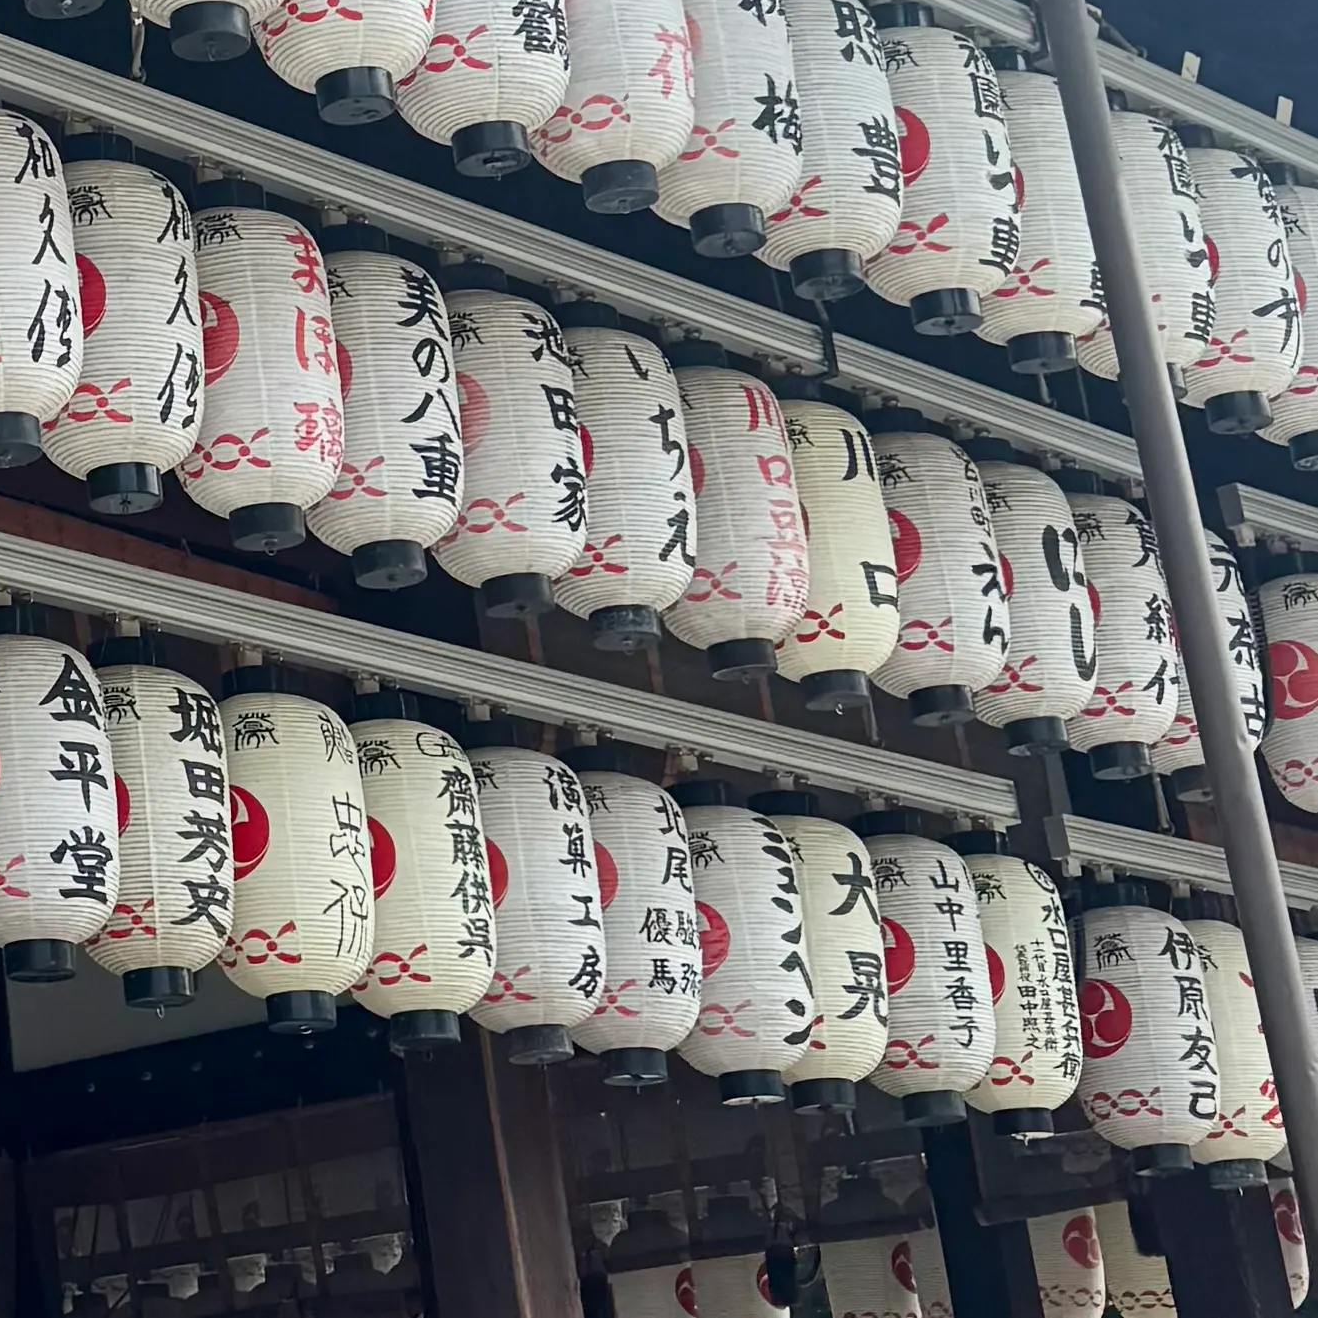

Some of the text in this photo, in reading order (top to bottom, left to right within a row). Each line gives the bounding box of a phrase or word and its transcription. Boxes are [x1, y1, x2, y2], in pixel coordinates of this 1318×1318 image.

[396, 265, 463, 507] 美の八重
[38, 653, 113, 906] 金平堂
[653, 795, 694, 895] 北尾
[638, 906, 678, 995] 優馬
[751, 816, 815, 1048] ミュンヘン
[928, 859, 981, 1050] 山中里香子
[1159, 925, 1217, 1121] 伊原友己
